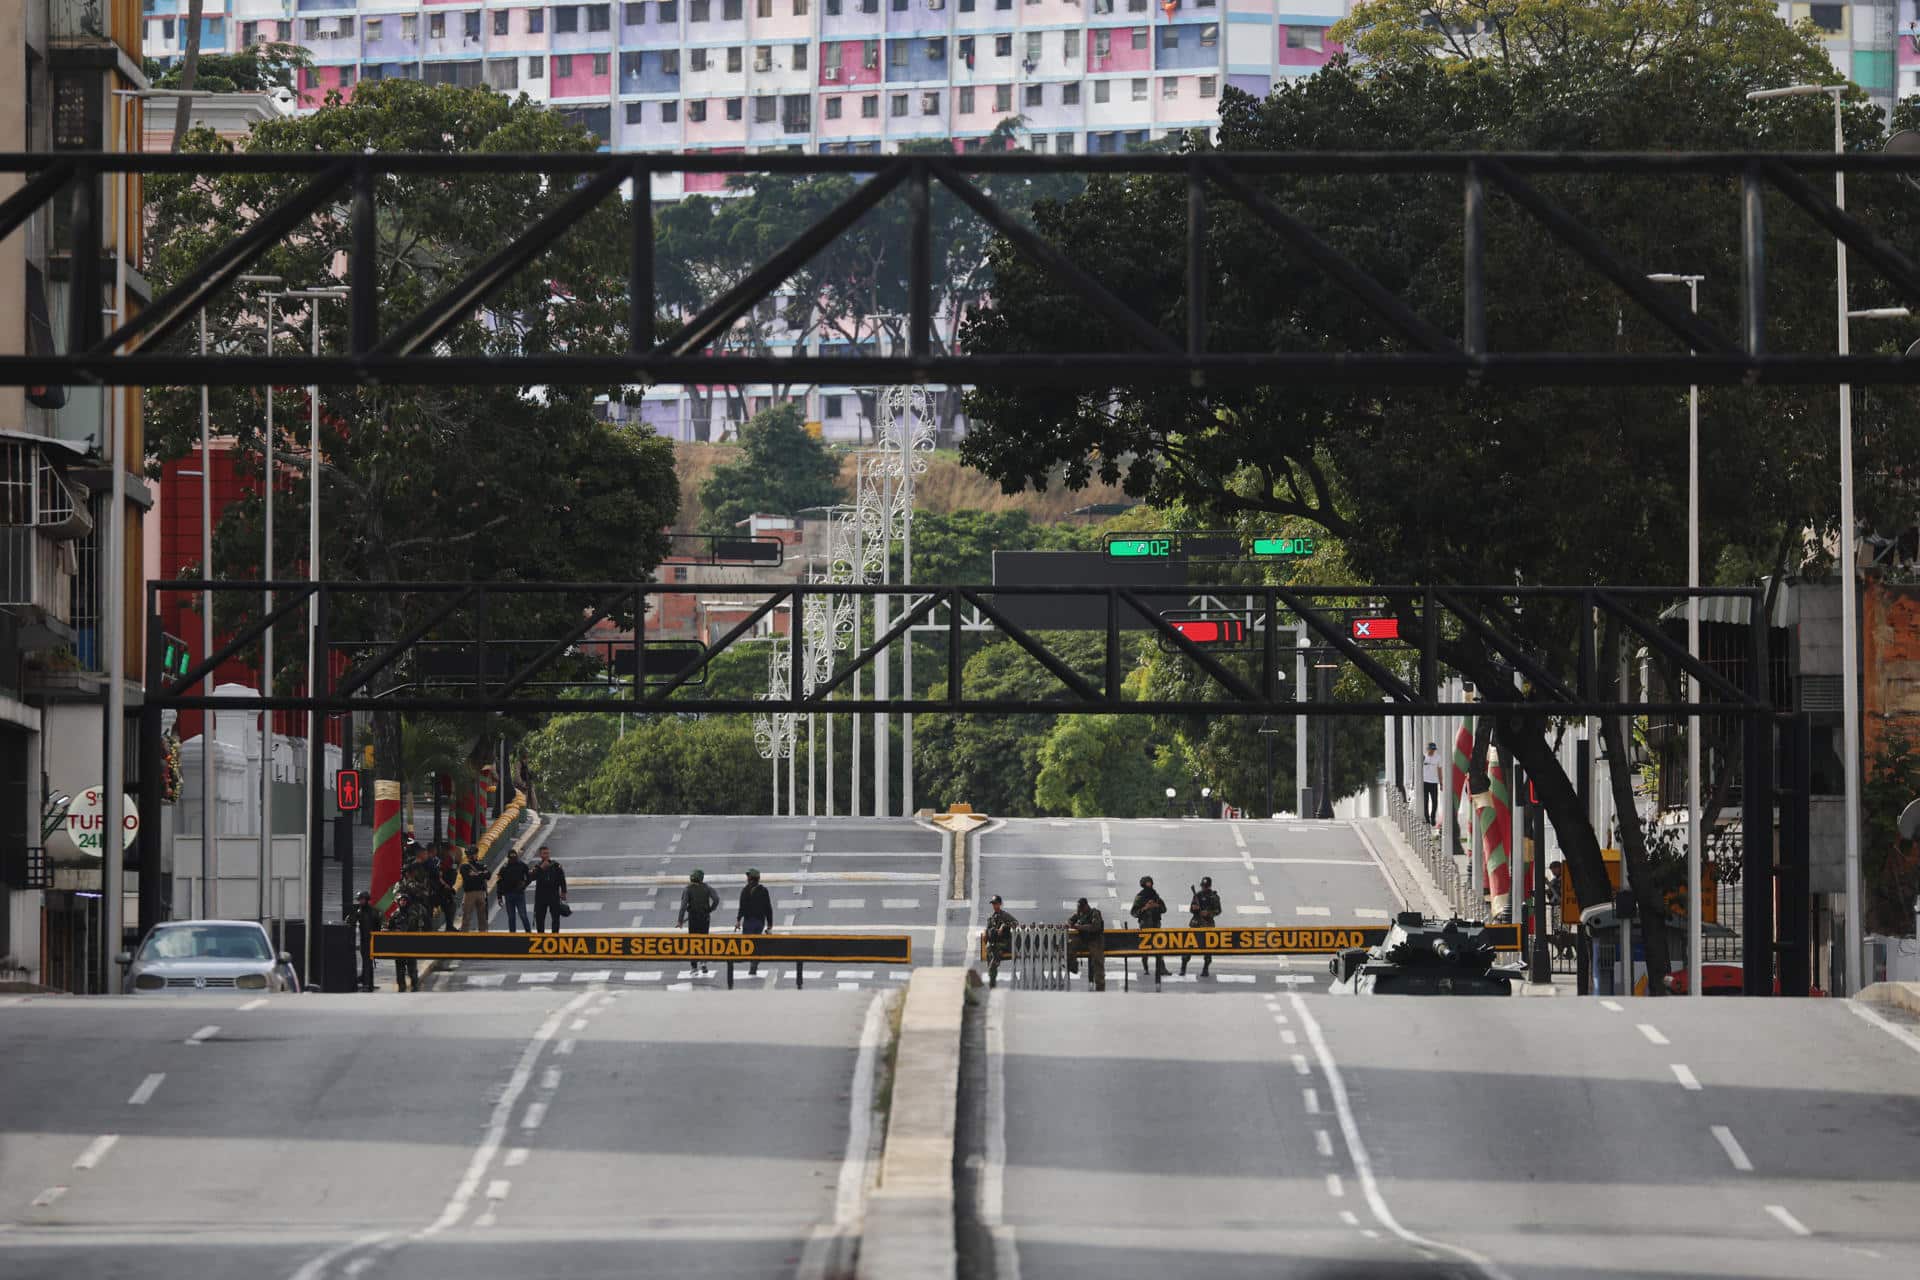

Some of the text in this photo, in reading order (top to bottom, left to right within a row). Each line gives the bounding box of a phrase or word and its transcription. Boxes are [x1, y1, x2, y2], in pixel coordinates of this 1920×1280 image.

[1150, 540, 1169, 556] 02
[528, 937, 755, 956] ZONA DE SEGURIDAD
[1138, 930, 1365, 950] ZONA DE SEGURIDAD
